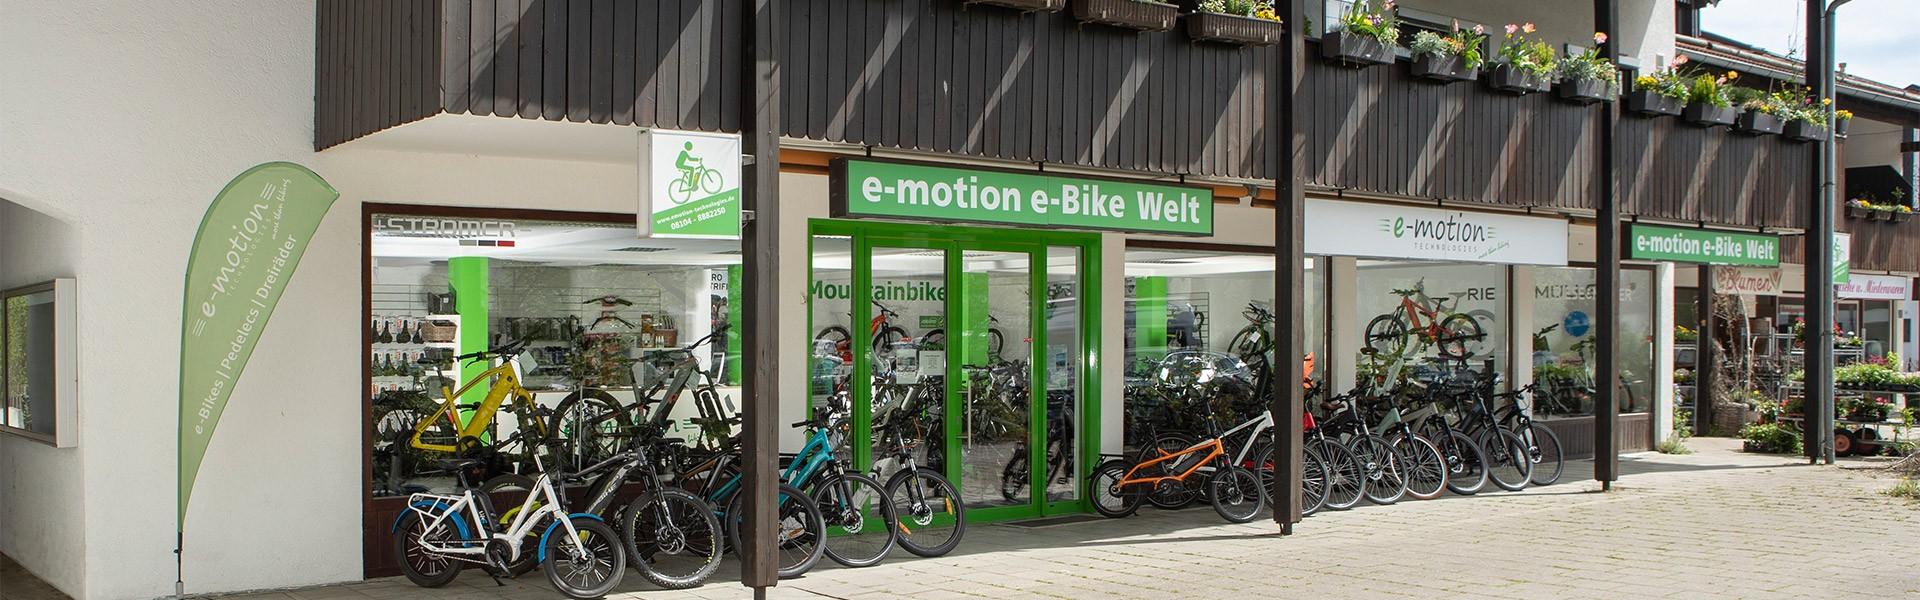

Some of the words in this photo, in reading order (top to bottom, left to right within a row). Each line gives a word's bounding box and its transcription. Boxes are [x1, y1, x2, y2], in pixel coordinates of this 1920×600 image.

[861, 175, 1022, 212] e-motion
[1030, 183, 1126, 218] e-Bike
[1137, 191, 1200, 224] Welt
[670, 217, 692, 230] 08104
[698, 207, 726, 222] 8882250
[1393, 212, 1486, 242] e-motion
[202, 200, 269, 318] e-motion
[1414, 242, 1478, 254] TECHNOLOGIES
[1637, 233, 1700, 255] e-motion
[1703, 236, 1742, 258] e-Bike
[1746, 239, 1774, 261] Welt
[1726, 266, 1773, 292] Blumen
[194, 379, 224, 436] e-Bikes
[222, 307, 261, 371] Pedelecs
[256, 233, 297, 300] Dreiräder
